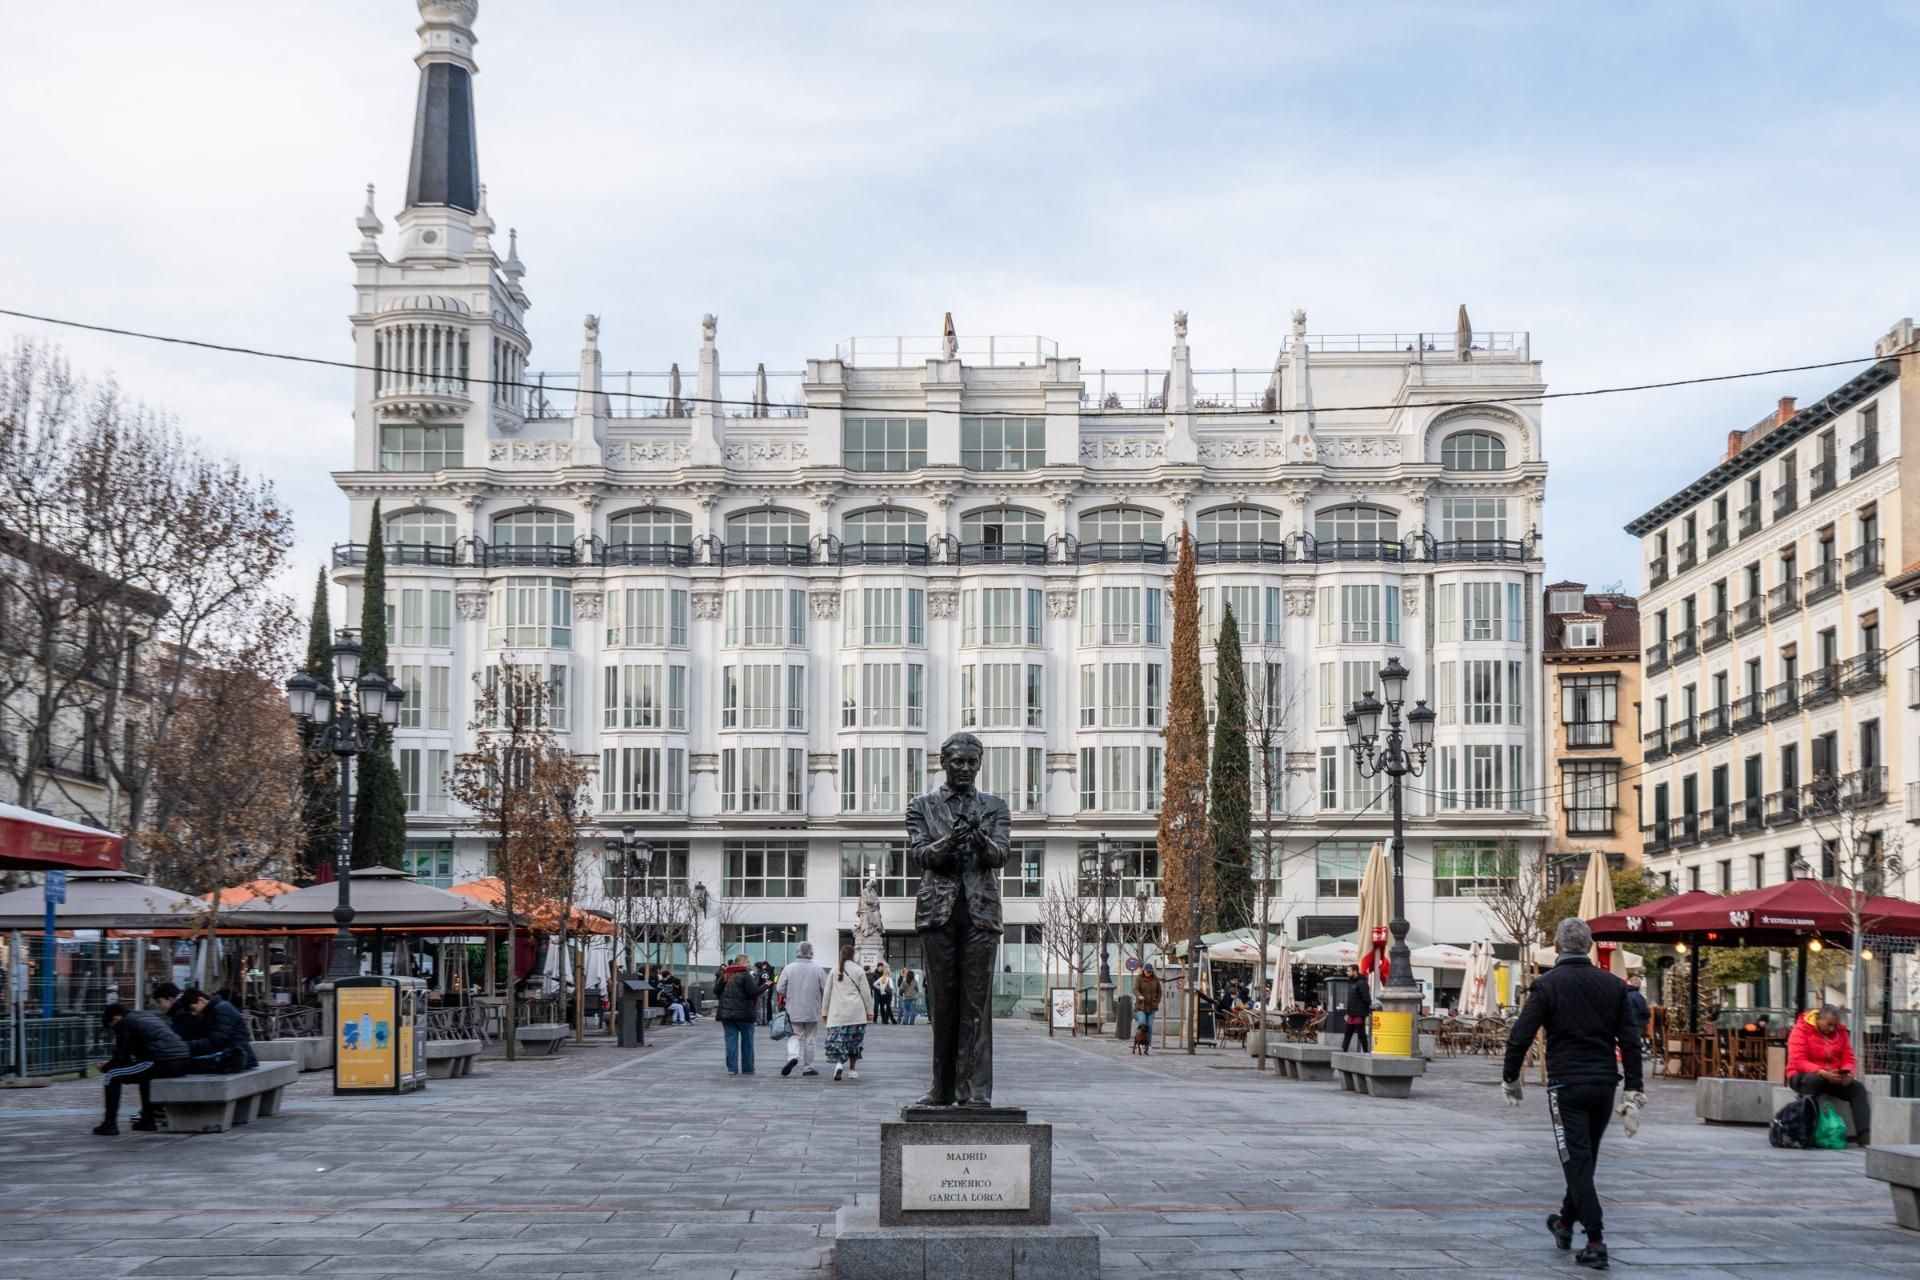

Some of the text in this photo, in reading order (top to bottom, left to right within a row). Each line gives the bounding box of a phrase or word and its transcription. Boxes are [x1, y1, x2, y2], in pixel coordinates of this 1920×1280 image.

[946, 1152, 987, 1161] MADRID
[963, 1166, 970, 1175] A
[941, 1180, 992, 1188] FEDERICO
[971, 1193, 1004, 1202] LORCA
